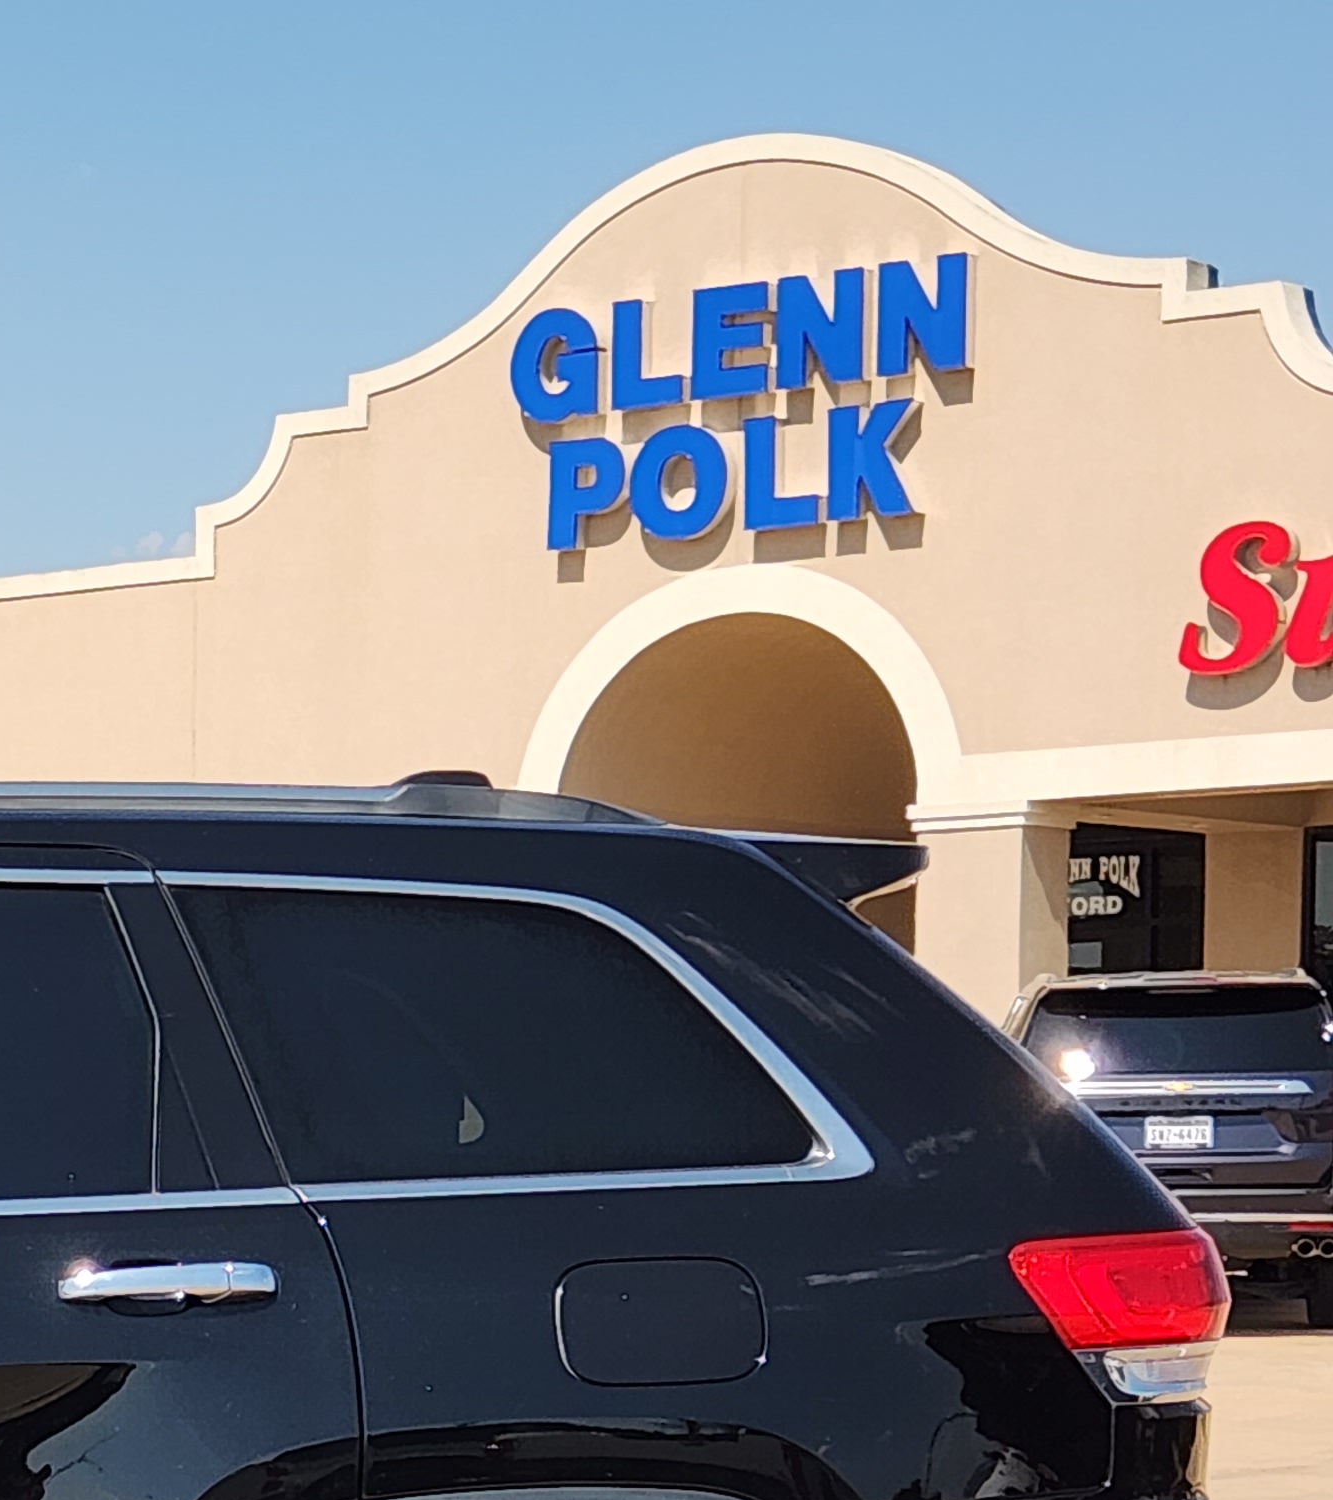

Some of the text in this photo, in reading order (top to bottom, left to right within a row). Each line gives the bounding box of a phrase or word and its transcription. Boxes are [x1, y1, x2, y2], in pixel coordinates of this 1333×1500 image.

[511, 252, 967, 423] GLENN
[547, 398, 914, 550] POLK
[1067, 895, 1123, 916] ORD
[1098, 855, 1141, 898] POLK
